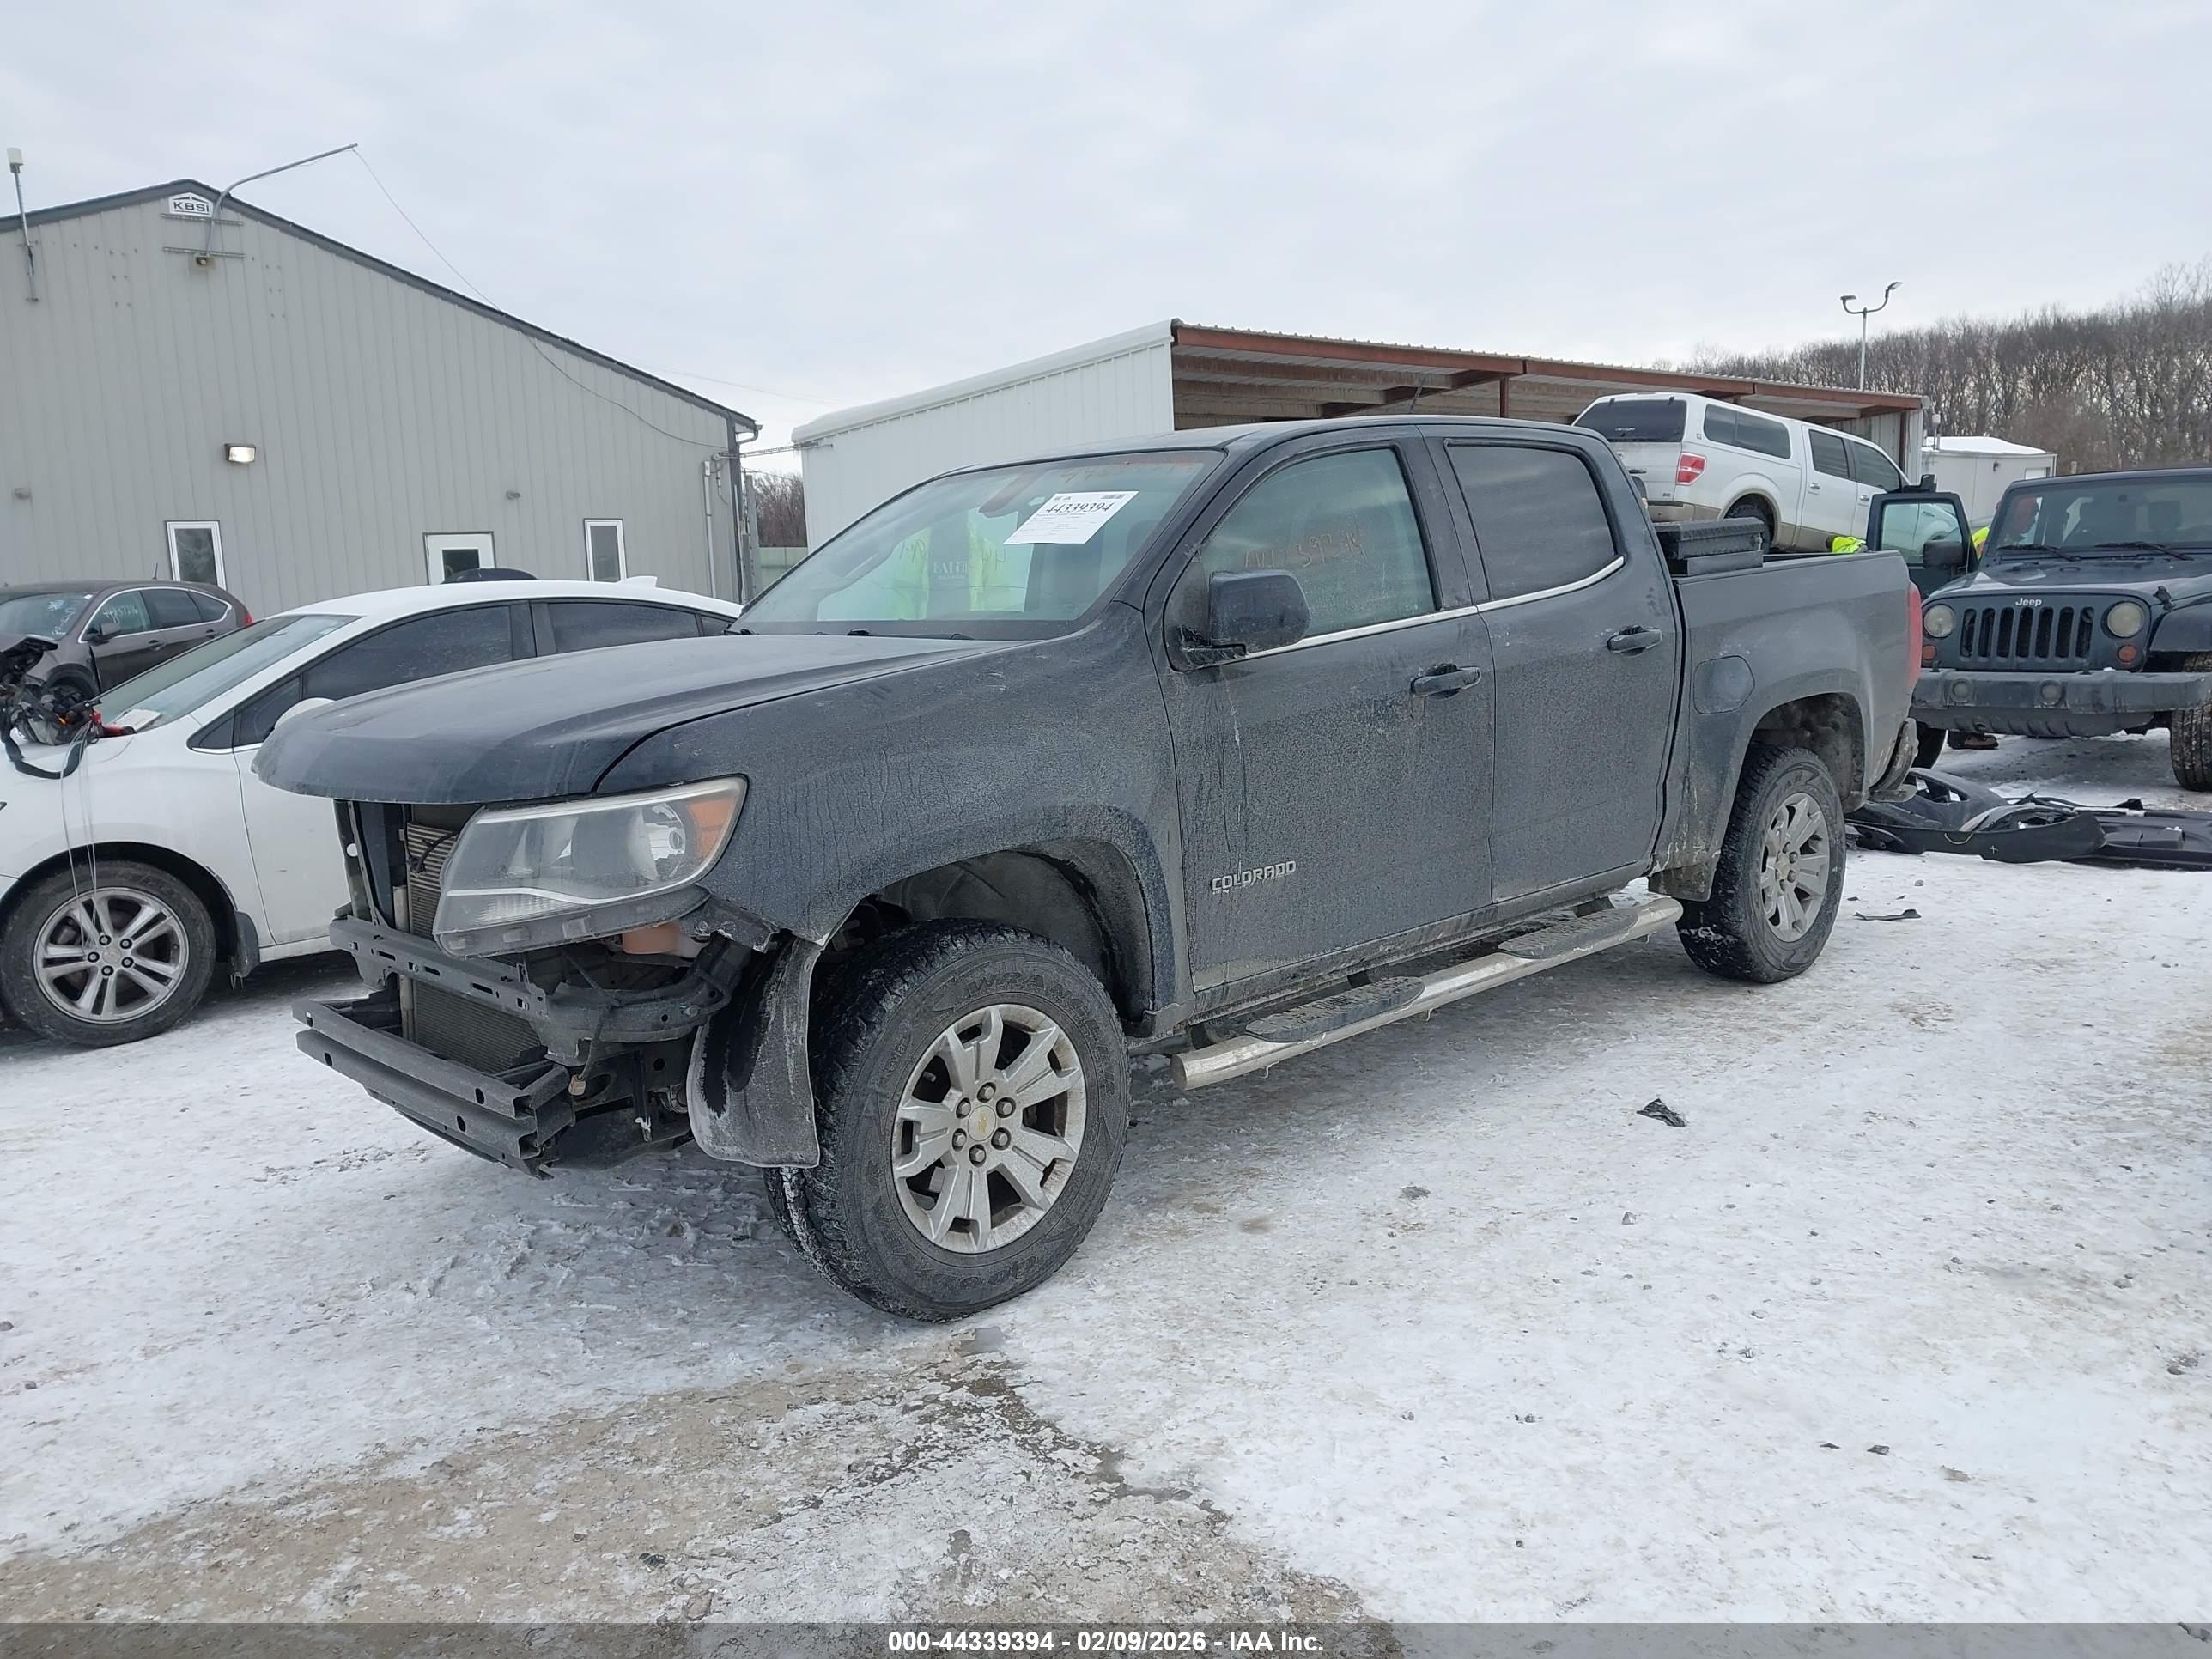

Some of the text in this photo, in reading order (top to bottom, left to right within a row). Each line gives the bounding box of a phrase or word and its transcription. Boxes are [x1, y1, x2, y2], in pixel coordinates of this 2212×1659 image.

[173, 201, 210, 213] KBSI
[1045, 501, 1115, 514] 44339394
[2014, 597, 2043, 607] Jeep
[1211, 860, 1297, 891] COLORADO
